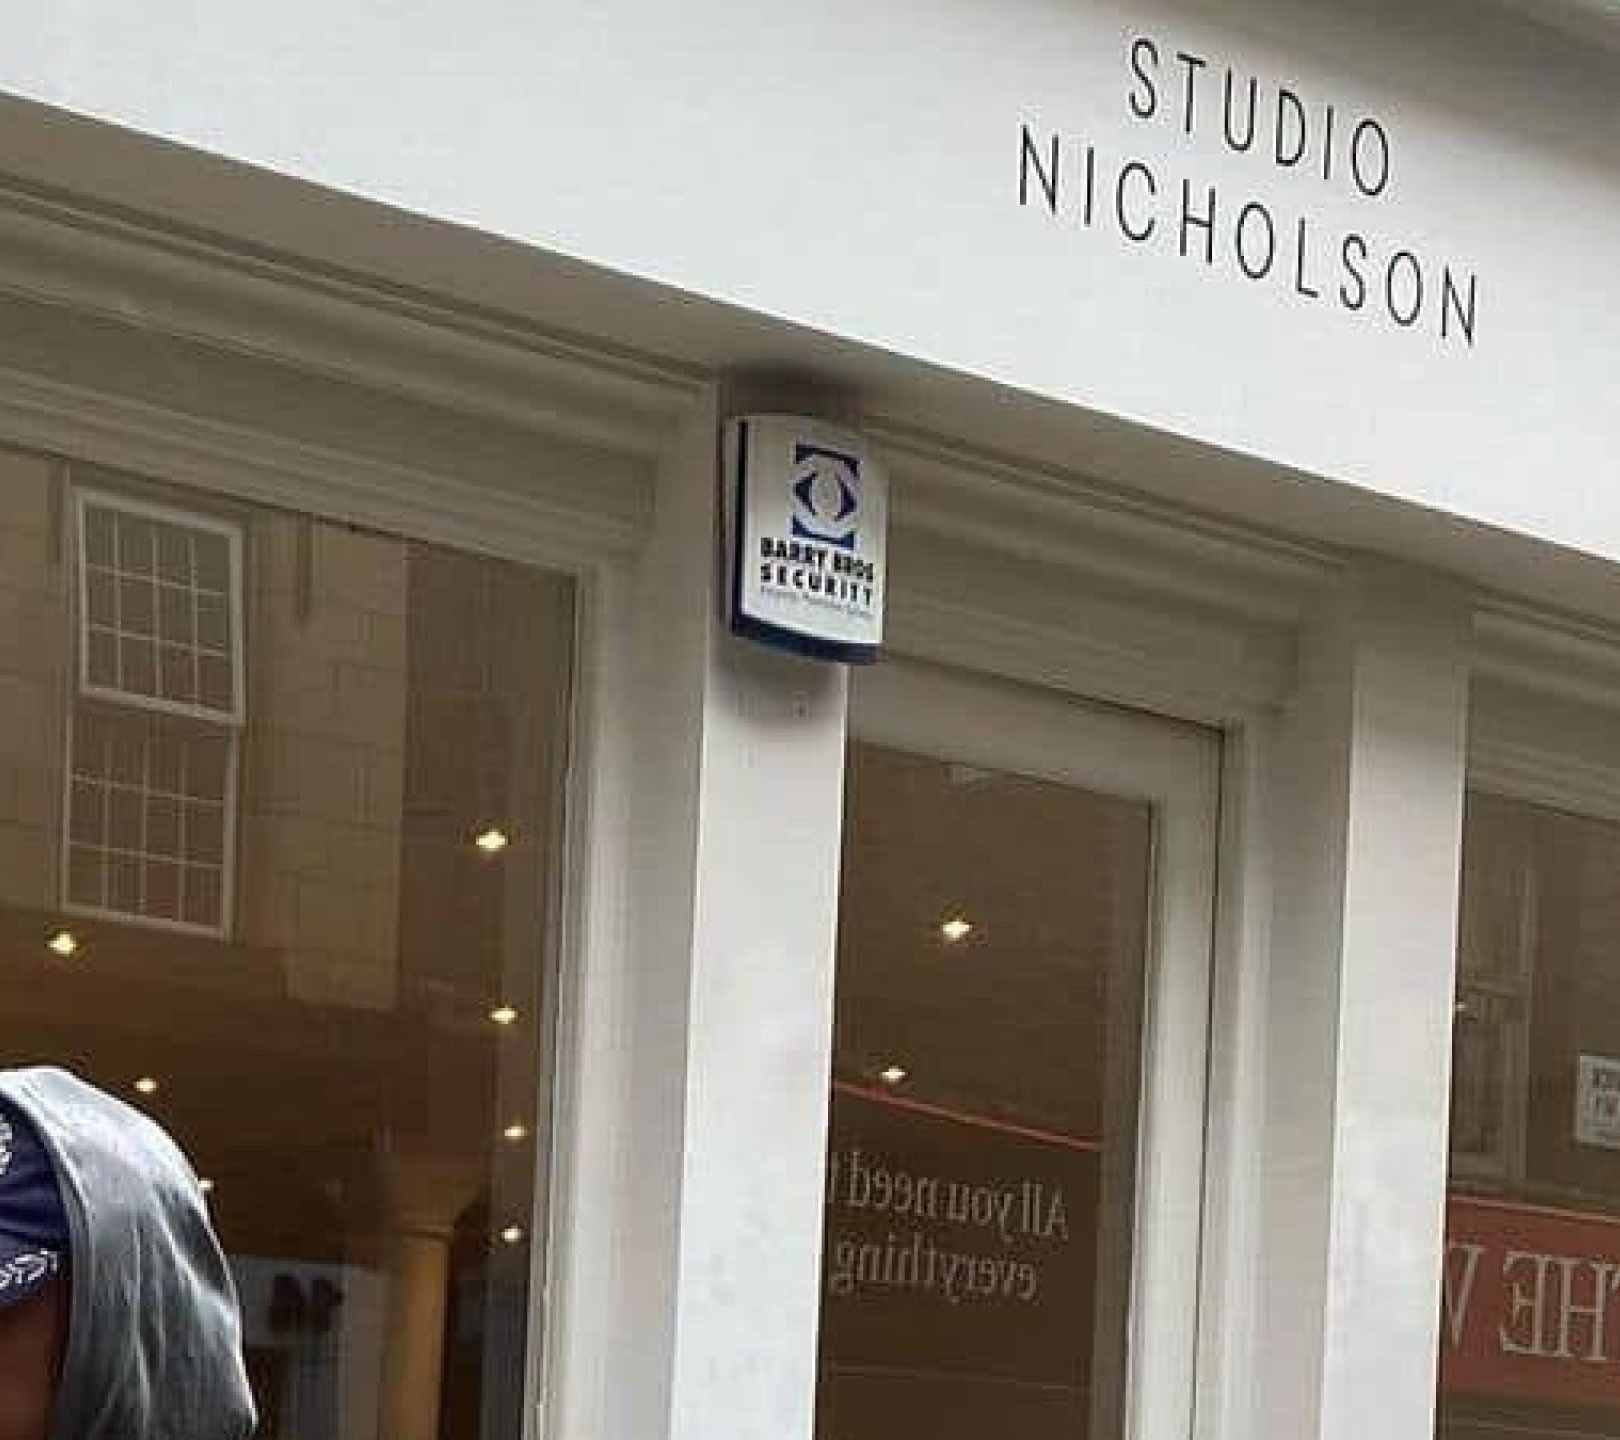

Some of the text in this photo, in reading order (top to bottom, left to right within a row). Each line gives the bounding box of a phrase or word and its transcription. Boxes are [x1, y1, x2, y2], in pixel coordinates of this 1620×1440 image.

[1128, 38, 1390, 196] STUDIO
[1018, 123, 1477, 347] NICHOLSON
[760, 564, 873, 606] SECURITY
